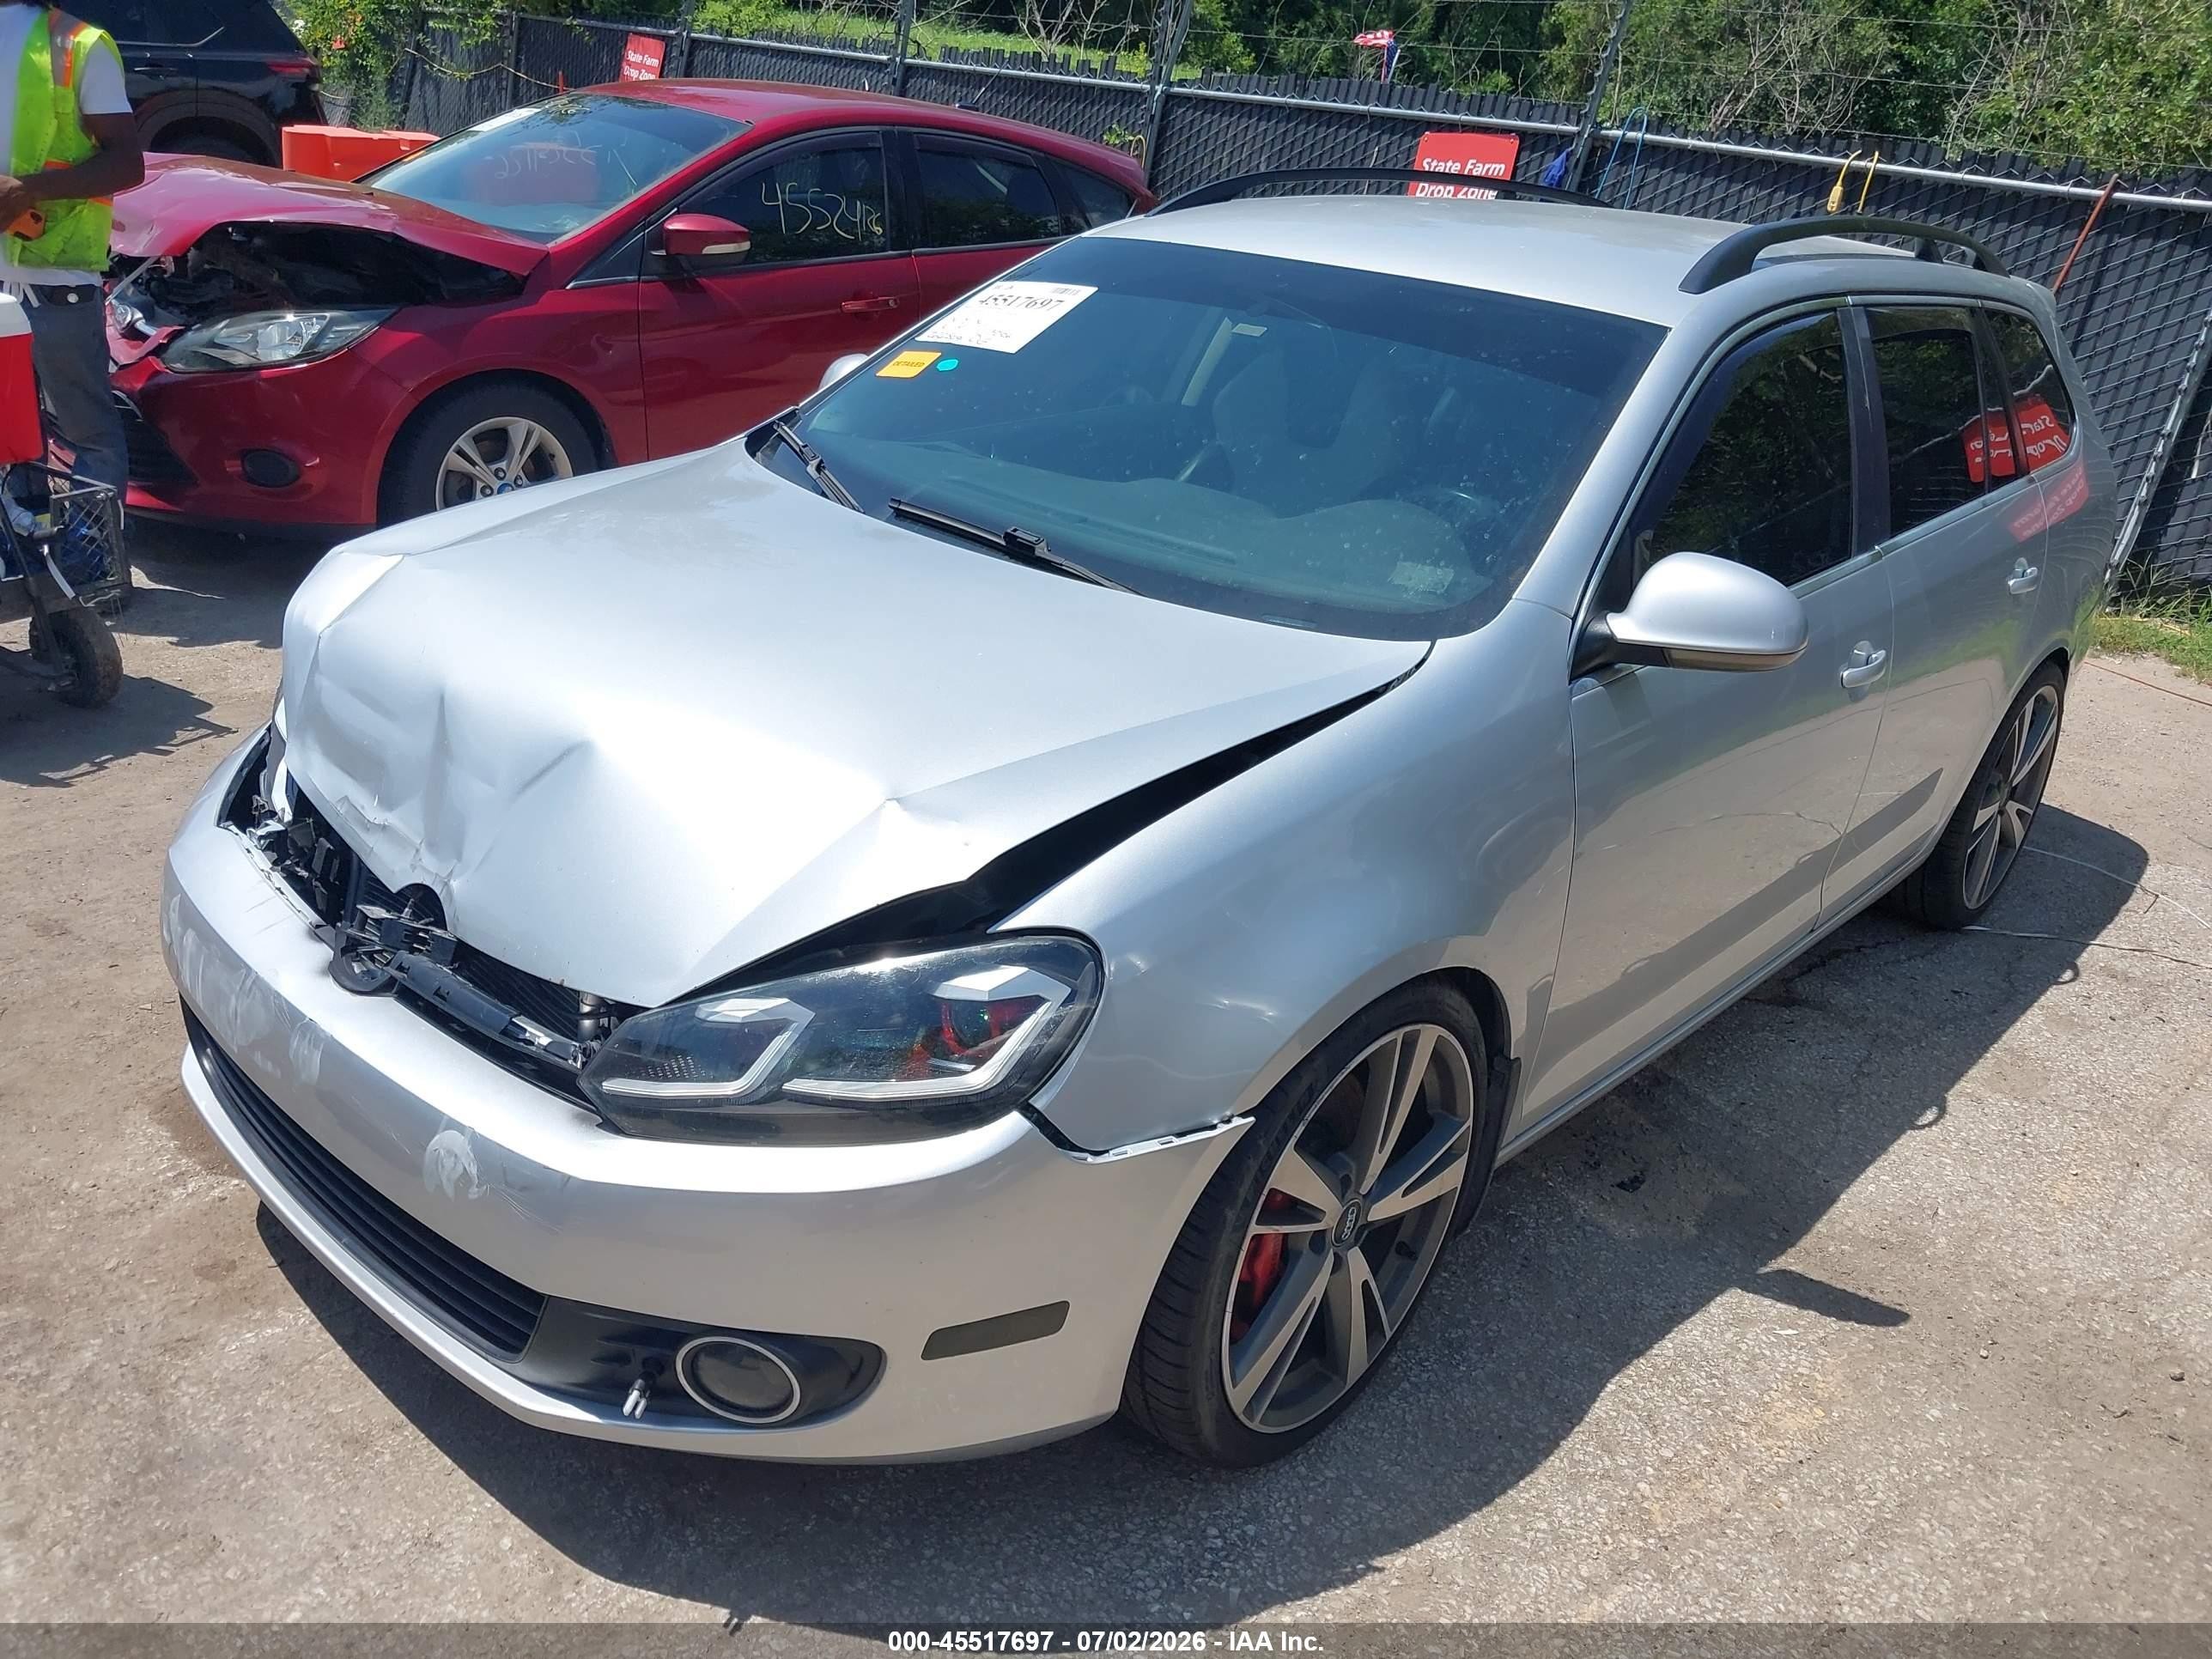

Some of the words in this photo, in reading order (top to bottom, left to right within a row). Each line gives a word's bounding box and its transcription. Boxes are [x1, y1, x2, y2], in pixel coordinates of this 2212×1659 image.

[627, 50, 643, 64] State
[642, 54, 659, 68] Farm
[623, 65, 640, 82] Drop
[1422, 157, 1461, 174] State
[1463, 159, 1505, 177] Farm
[1415, 183, 1455, 198] Drop
